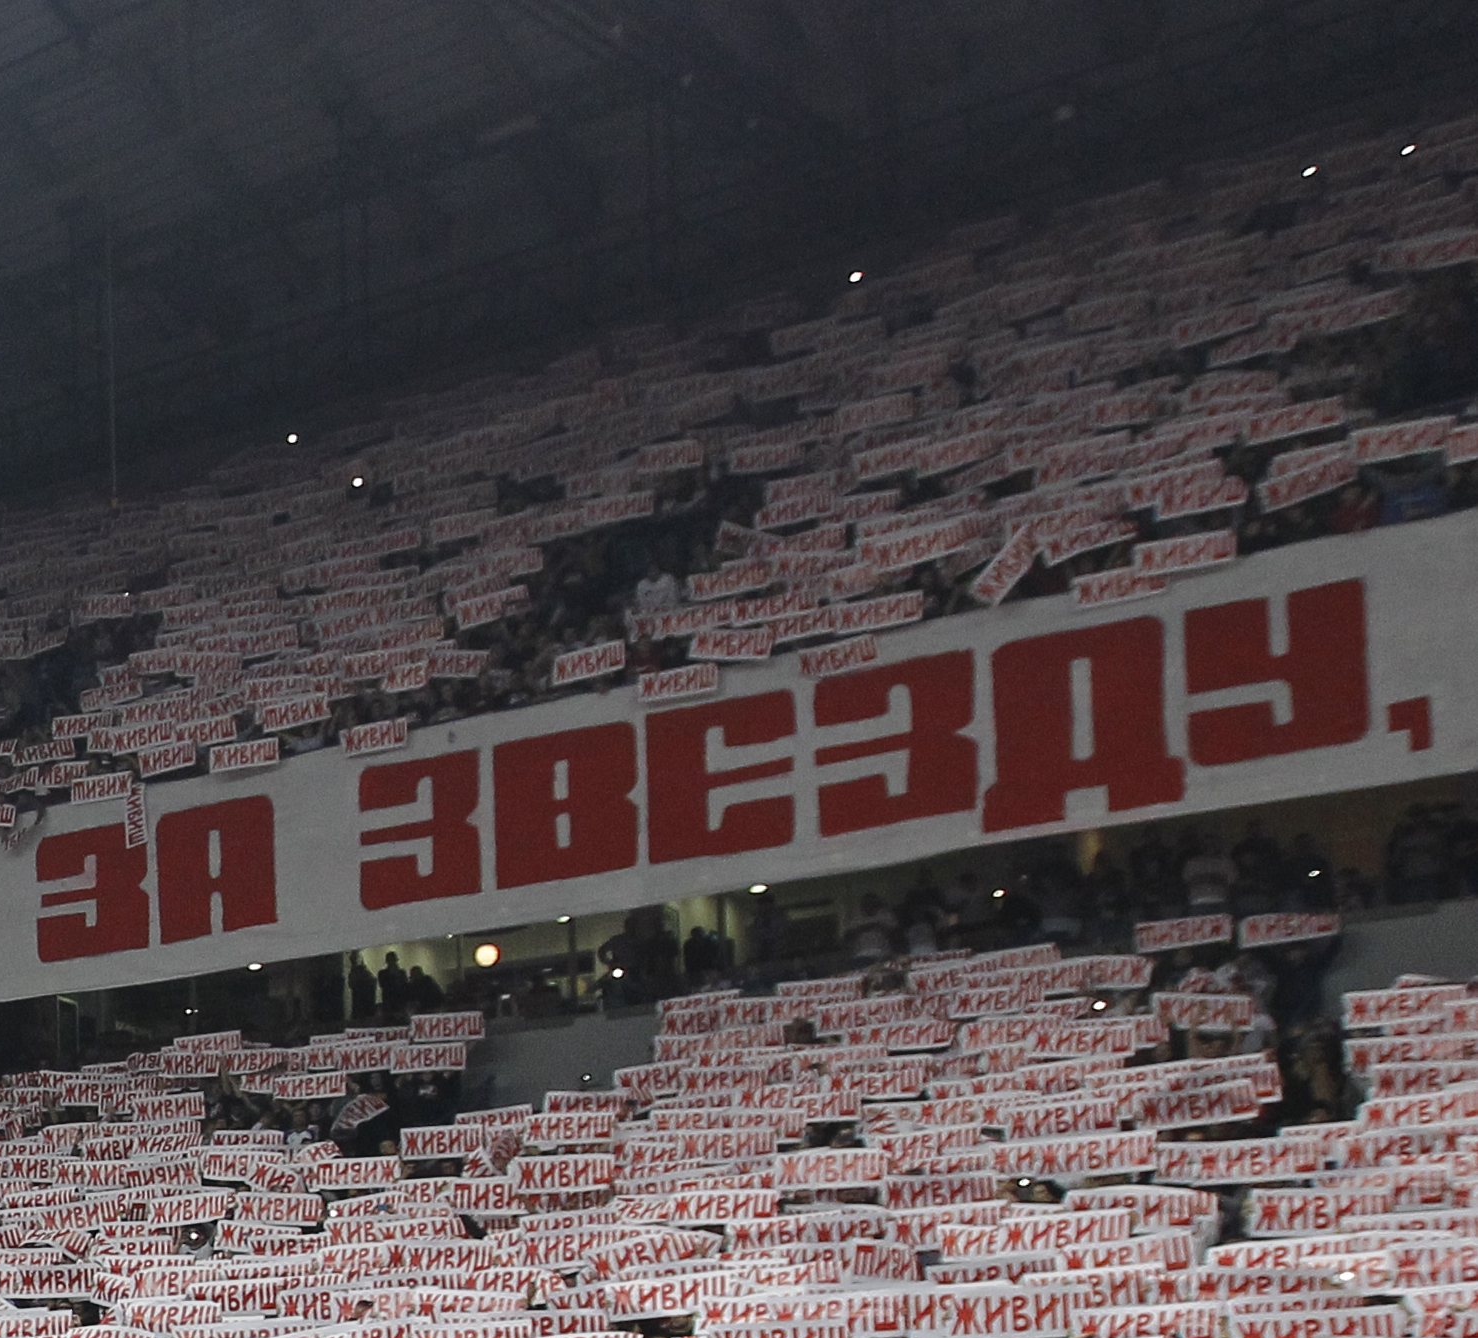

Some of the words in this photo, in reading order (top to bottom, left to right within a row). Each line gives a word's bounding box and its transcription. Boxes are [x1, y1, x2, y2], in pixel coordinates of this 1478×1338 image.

[211, 742, 278, 768] ЖИВИШ
[36, 794, 279, 963] ЗА
[359, 579, 1432, 911] ЗВЕЗДУ,
[413, 1014, 483, 1039] ЖИВИШ
[392, 1046, 465, 1070] ЖИВИШ
